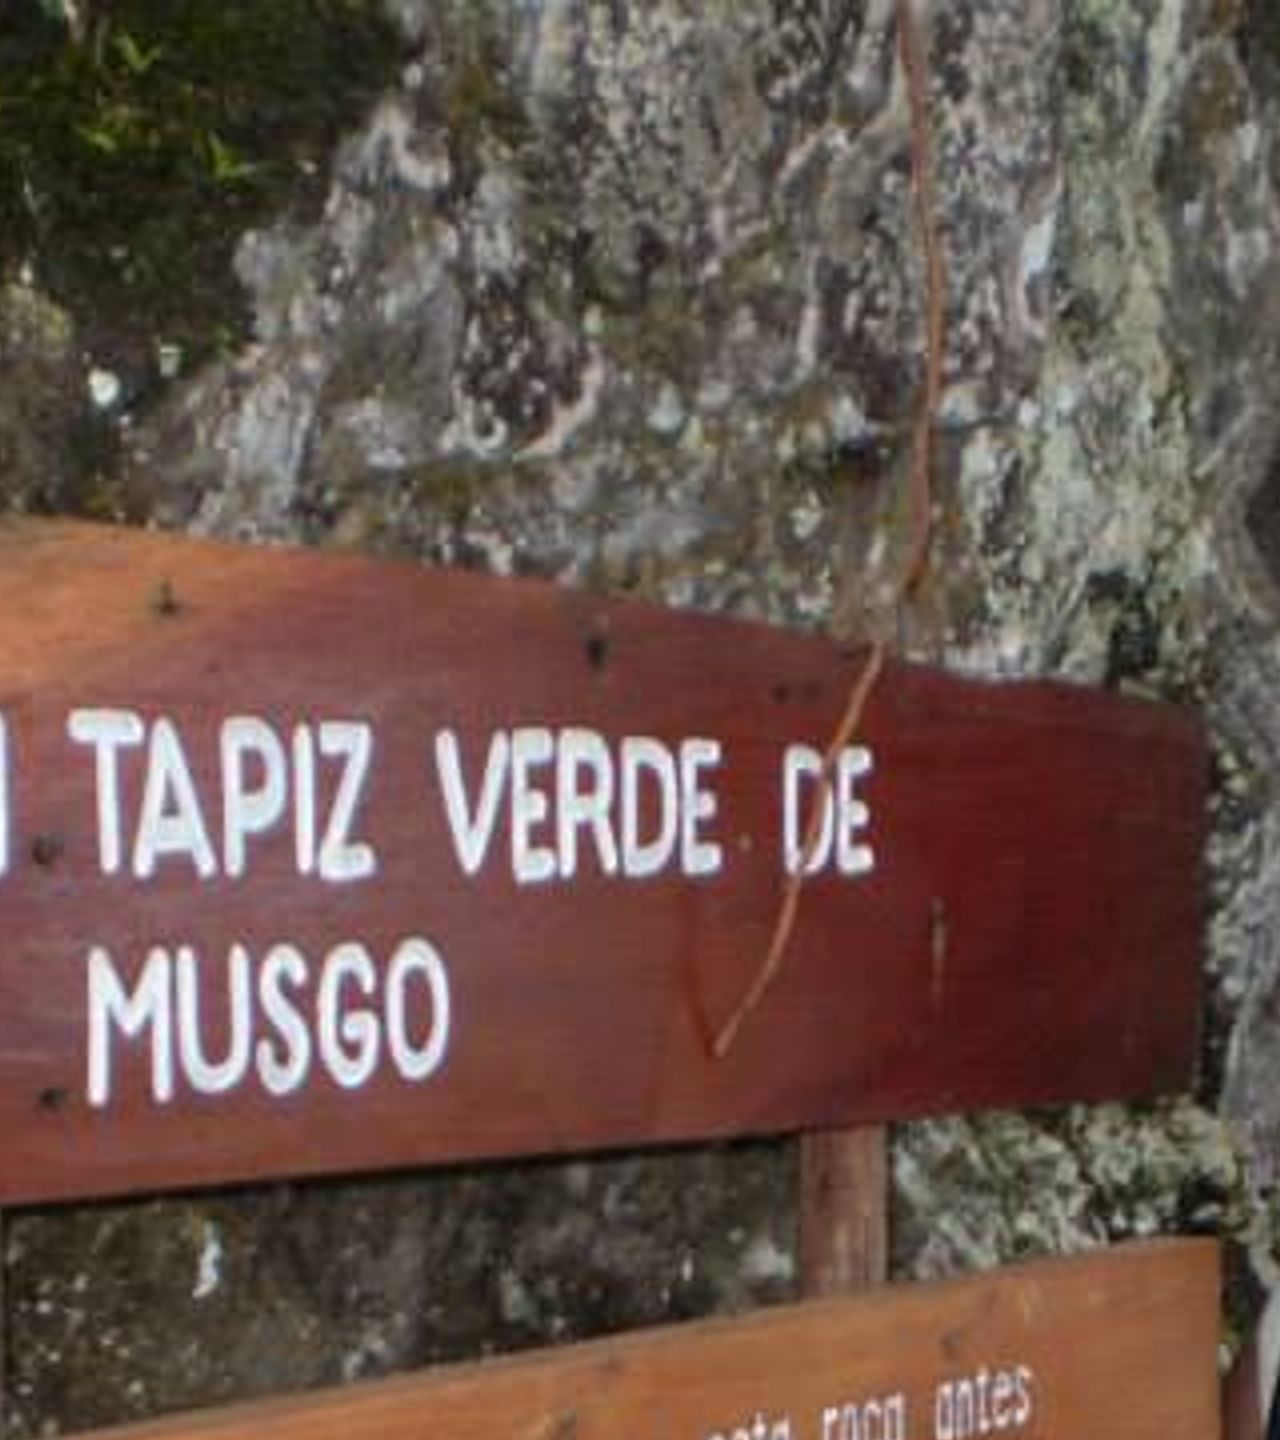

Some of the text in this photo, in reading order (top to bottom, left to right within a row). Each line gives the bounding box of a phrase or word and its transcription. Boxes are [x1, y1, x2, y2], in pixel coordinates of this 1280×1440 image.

[68, 710, 375, 883] TAPIZ
[436, 729, 722, 884] VERDE
[783, 745, 875, 876] DE
[88, 939, 450, 1106] MUSGO
